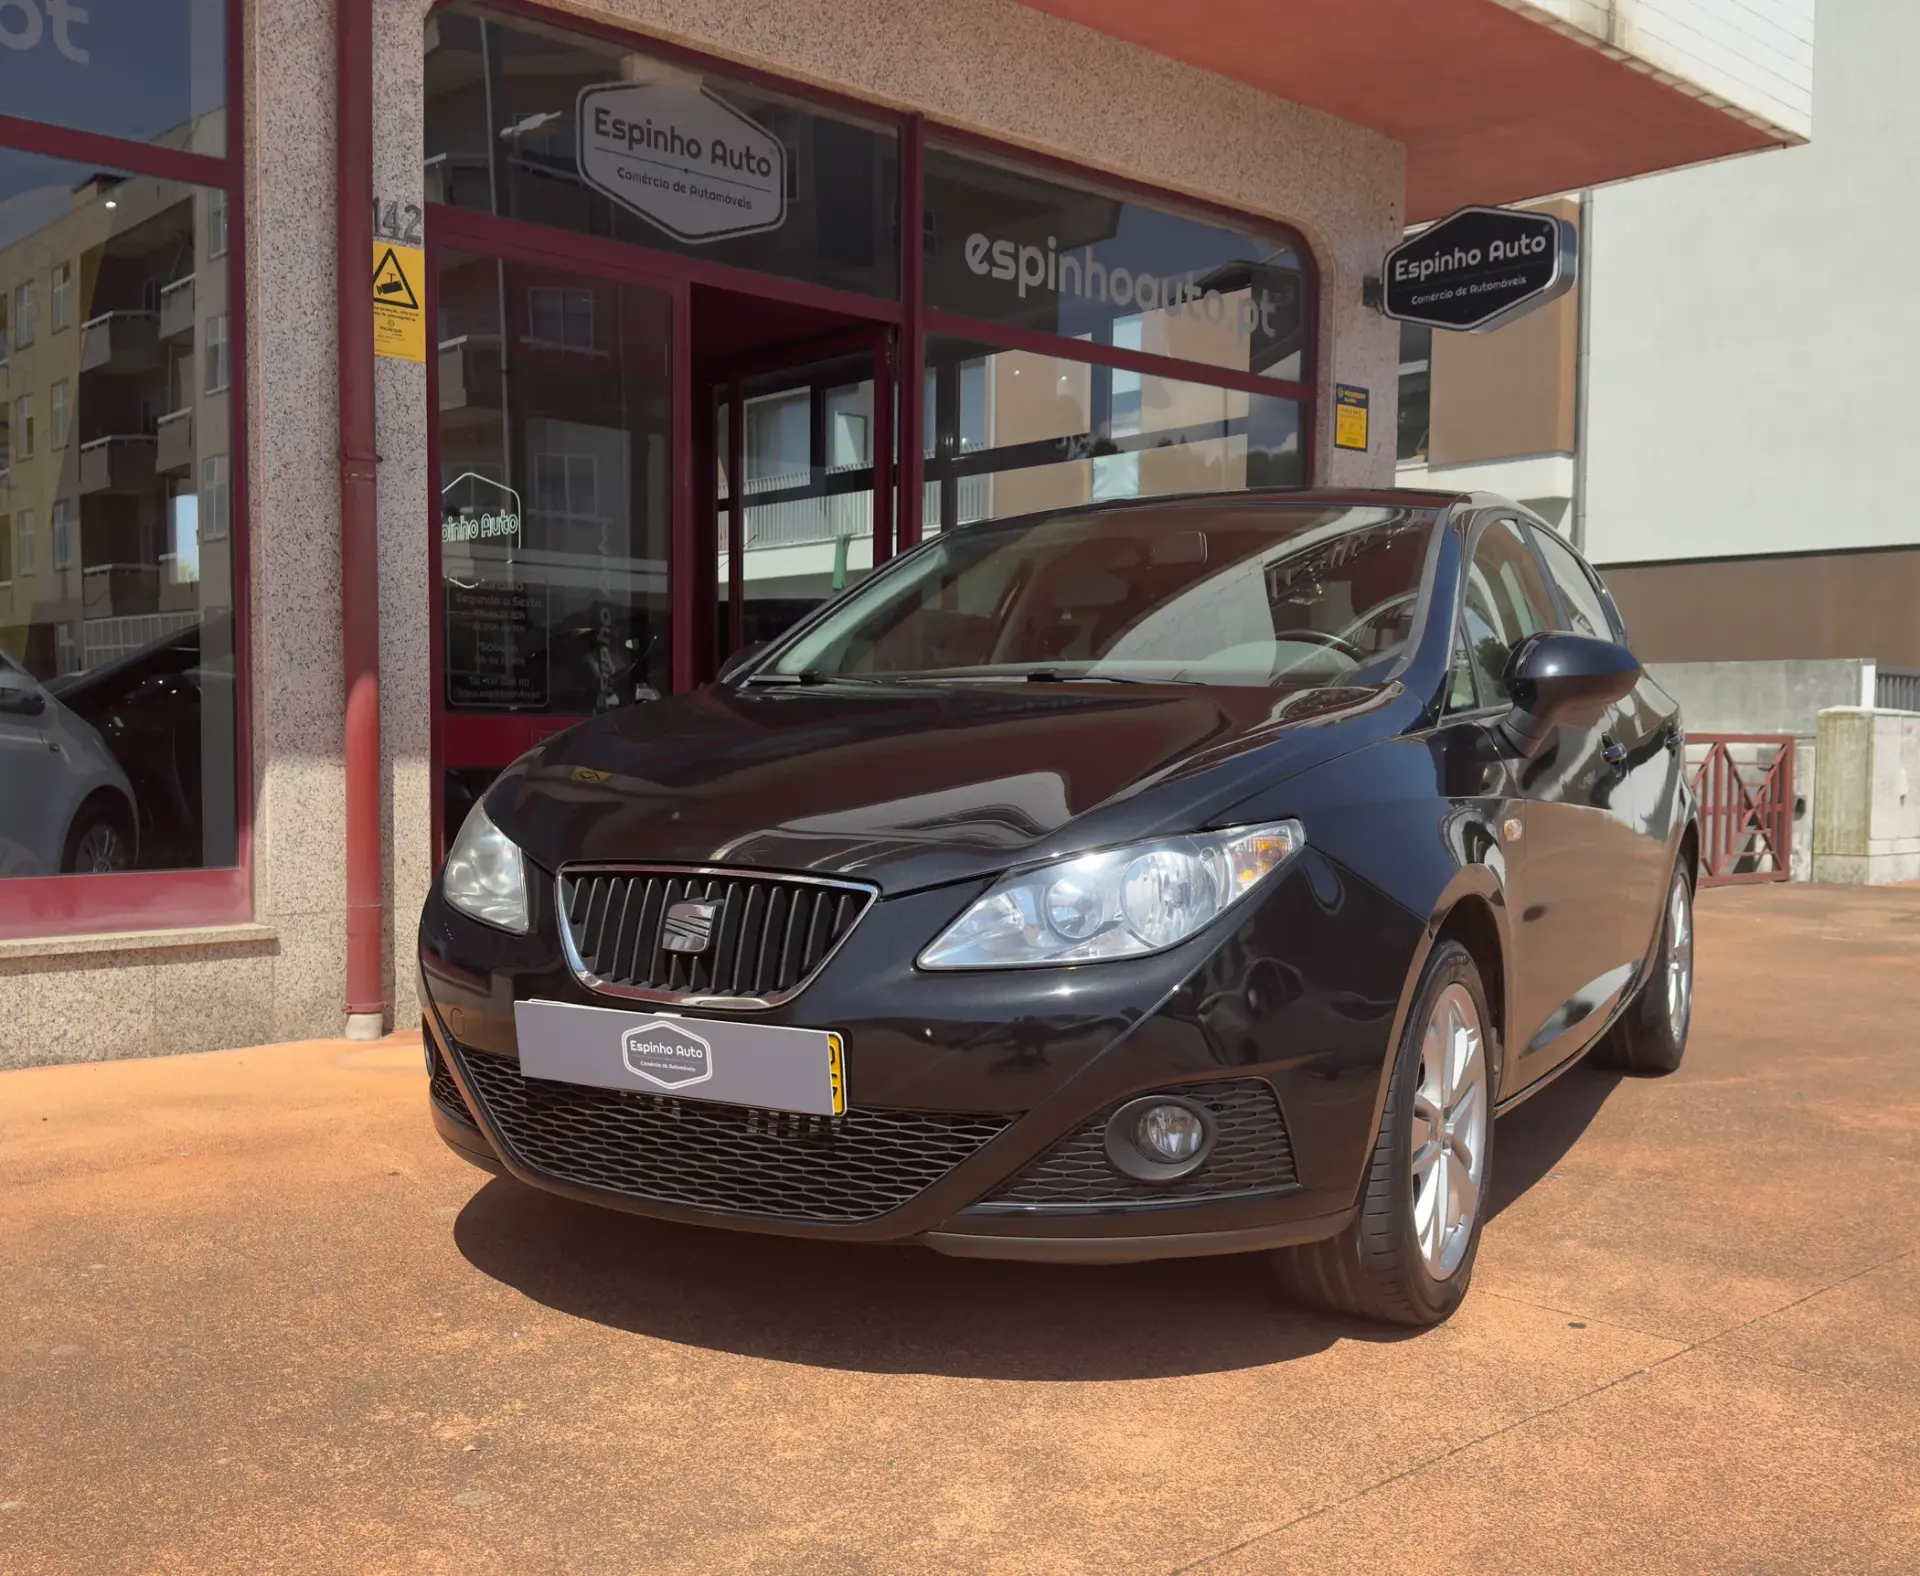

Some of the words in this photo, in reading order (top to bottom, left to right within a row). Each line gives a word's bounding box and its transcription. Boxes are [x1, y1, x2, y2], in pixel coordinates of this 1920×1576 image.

[594, 107, 702, 159] Espinho
[711, 140, 771, 177] Auto
[617, 166, 670, 190] Comércio
[673, 181, 686, 194] de
[690, 185, 752, 210] Automóveis
[372, 196, 422, 245] 142
[1395, 247, 1481, 281] Espinho
[1489, 233, 1546, 262] Auto
[1411, 288, 1453, 305] Comércio
[1456, 286, 1467, 297] de
[1470, 275, 1527, 293] Automóveis
[481, 509, 518, 538] Auto
[630, 1040, 673, 1055] Espinho
[676, 1045, 703, 1058] Auto
